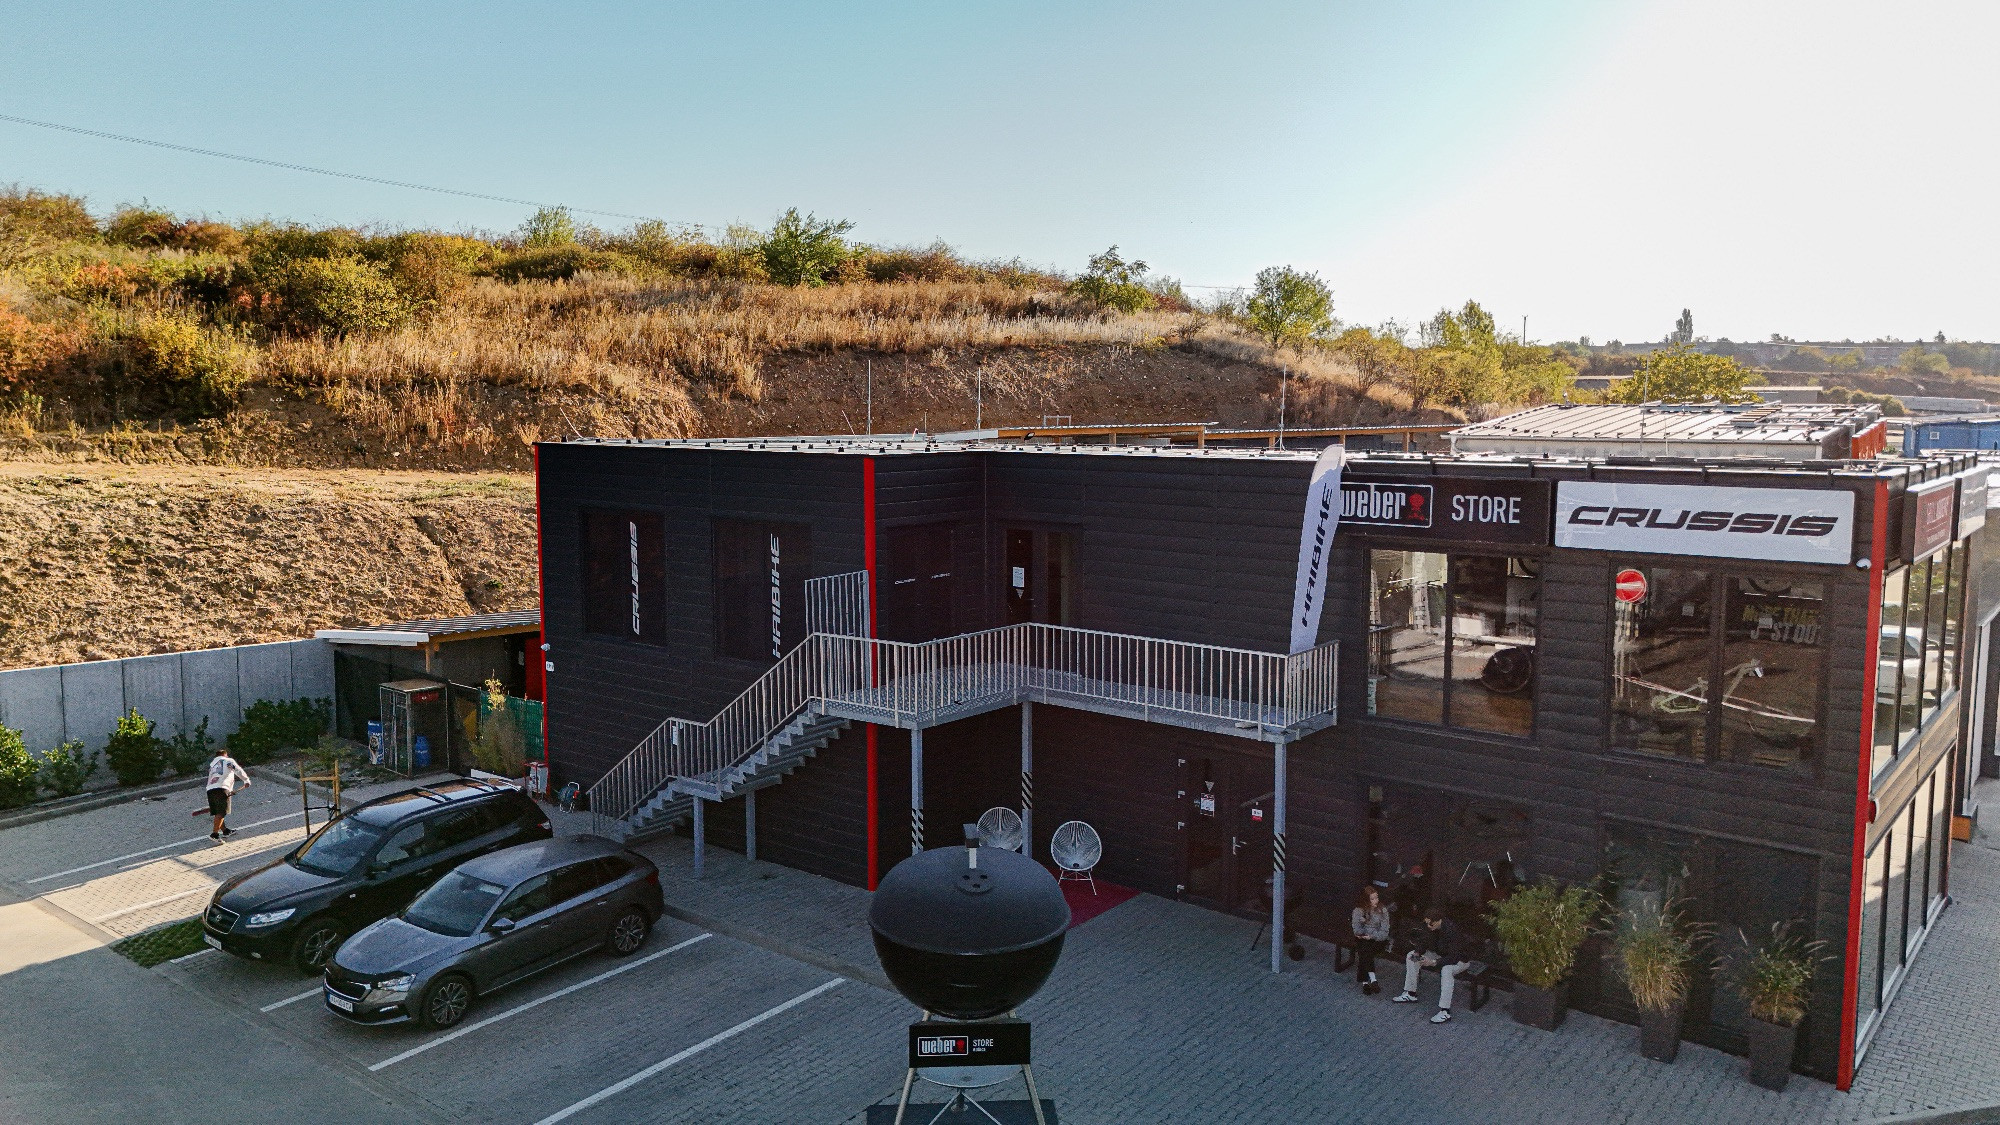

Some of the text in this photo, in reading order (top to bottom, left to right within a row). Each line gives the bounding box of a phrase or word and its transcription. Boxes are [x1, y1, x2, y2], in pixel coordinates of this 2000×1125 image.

[1339, 484, 1522, 524] weber STORE
[1567, 505, 1839, 537] CRUSSIS
[629, 521, 640, 635] CRUSSIS
[1302, 483, 1333, 628] HAIBIKE
[770, 533, 781, 659] HAIBIKE
[921, 1036, 956, 1054] weber
[972, 1038, 994, 1047] STORE
